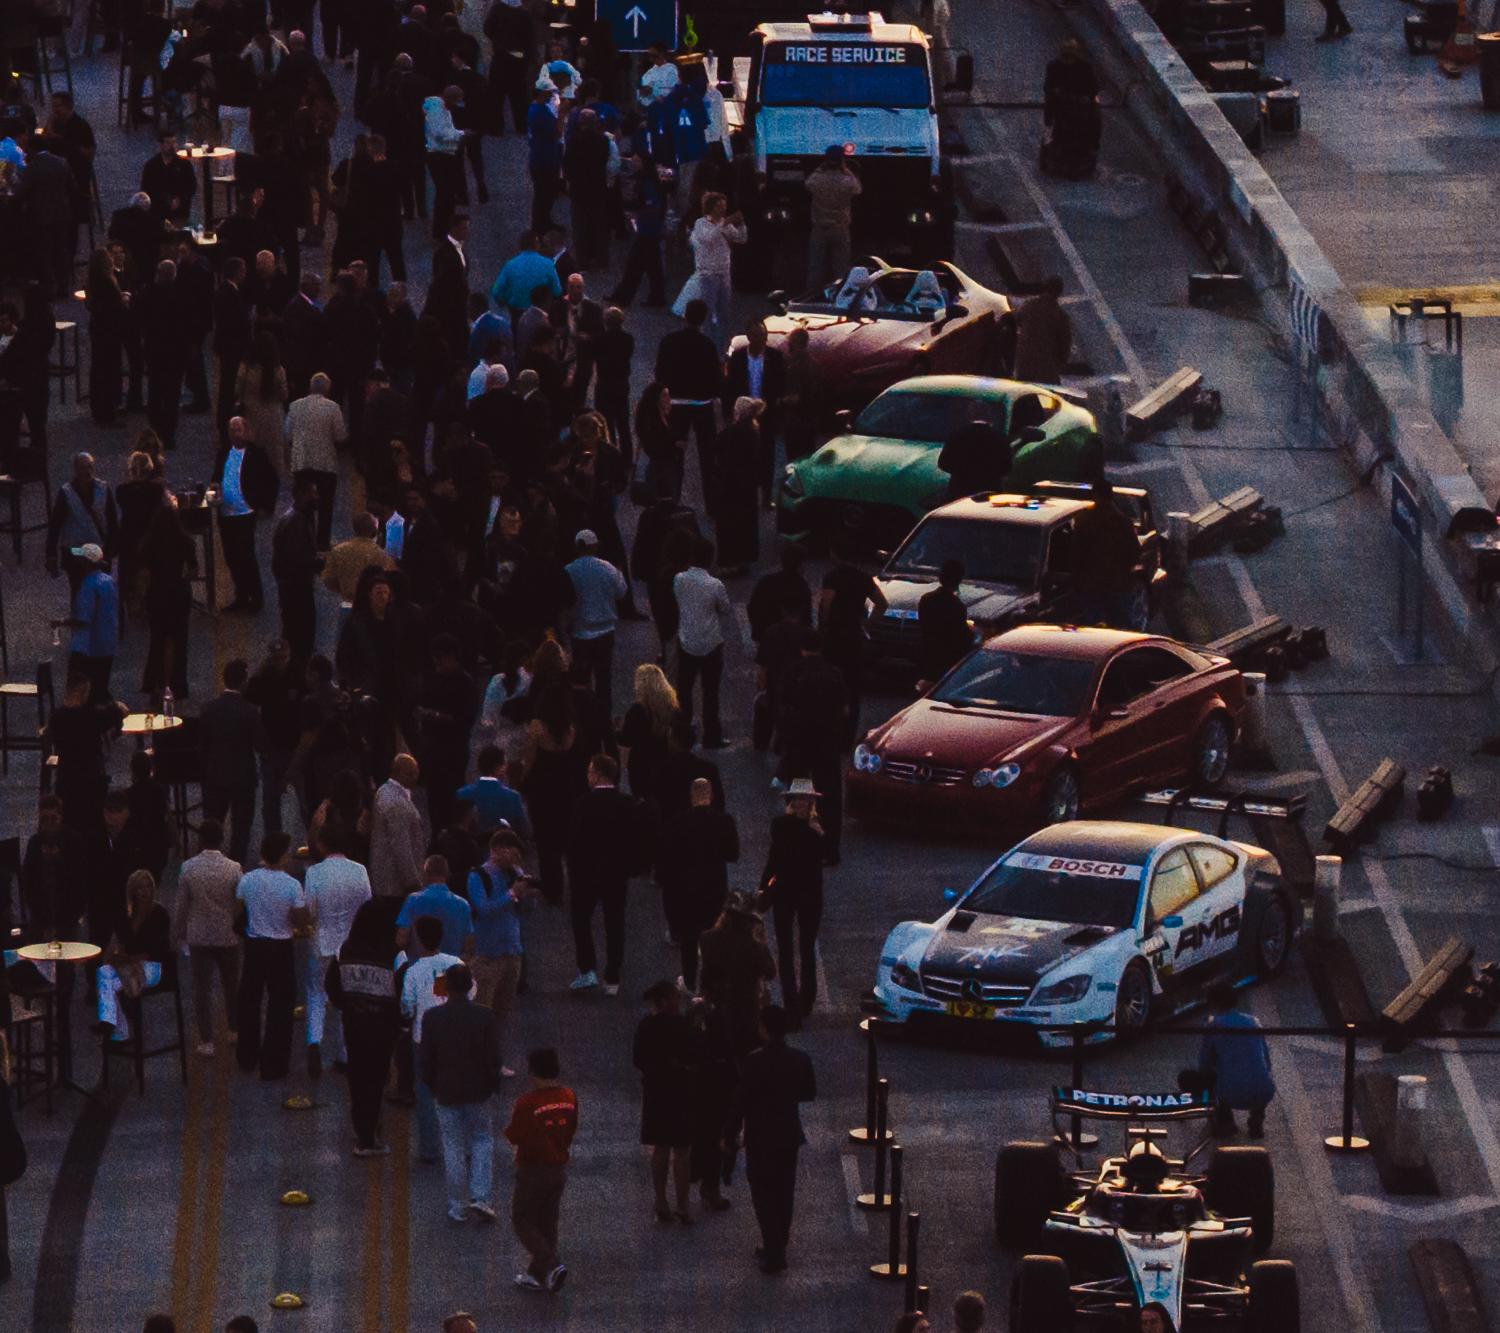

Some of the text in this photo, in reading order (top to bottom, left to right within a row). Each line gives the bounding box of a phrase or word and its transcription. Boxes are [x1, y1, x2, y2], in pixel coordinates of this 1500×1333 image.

[785, 46, 906, 63] RACE SERVICE
[1048, 858, 1127, 876] BOSCH
[1175, 905, 1241, 958] AMG
[1073, 1089, 1193, 1106] PETRONAS
